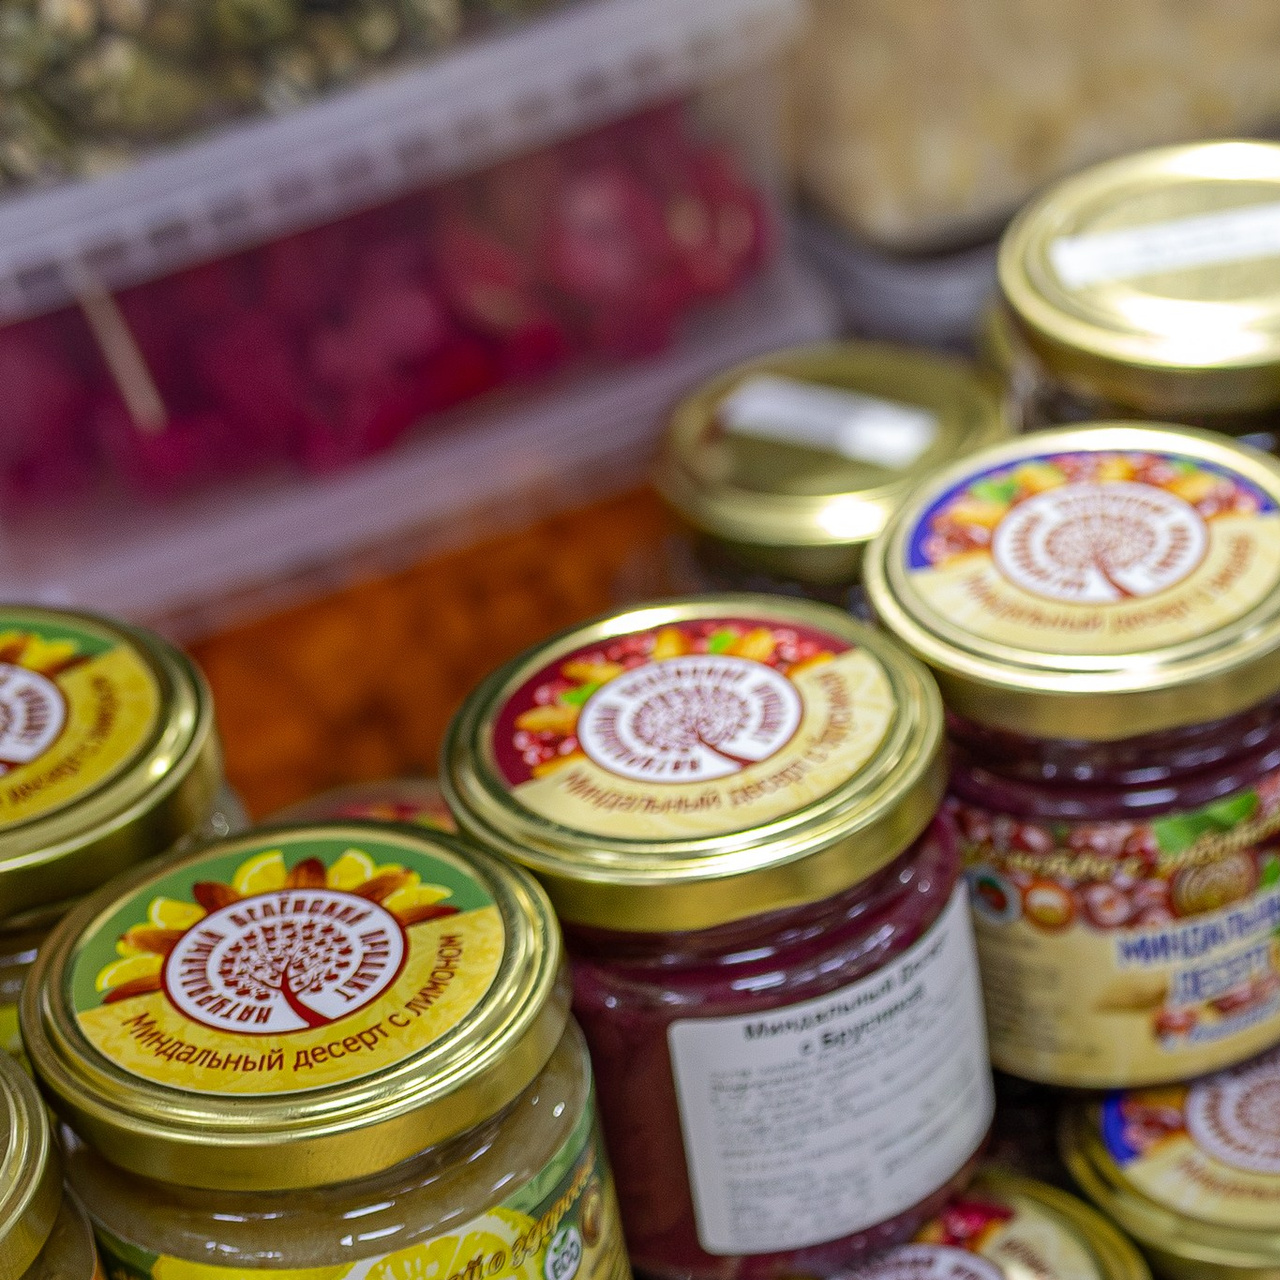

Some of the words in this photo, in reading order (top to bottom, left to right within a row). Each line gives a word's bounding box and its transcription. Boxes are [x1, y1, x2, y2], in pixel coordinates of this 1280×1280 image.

[122, 1012, 284, 1073] Миндальный
[292, 1024, 391, 1072] десерт
[388, 1011, 411, 1028] с
[409, 932, 465, 1018] лимоном
